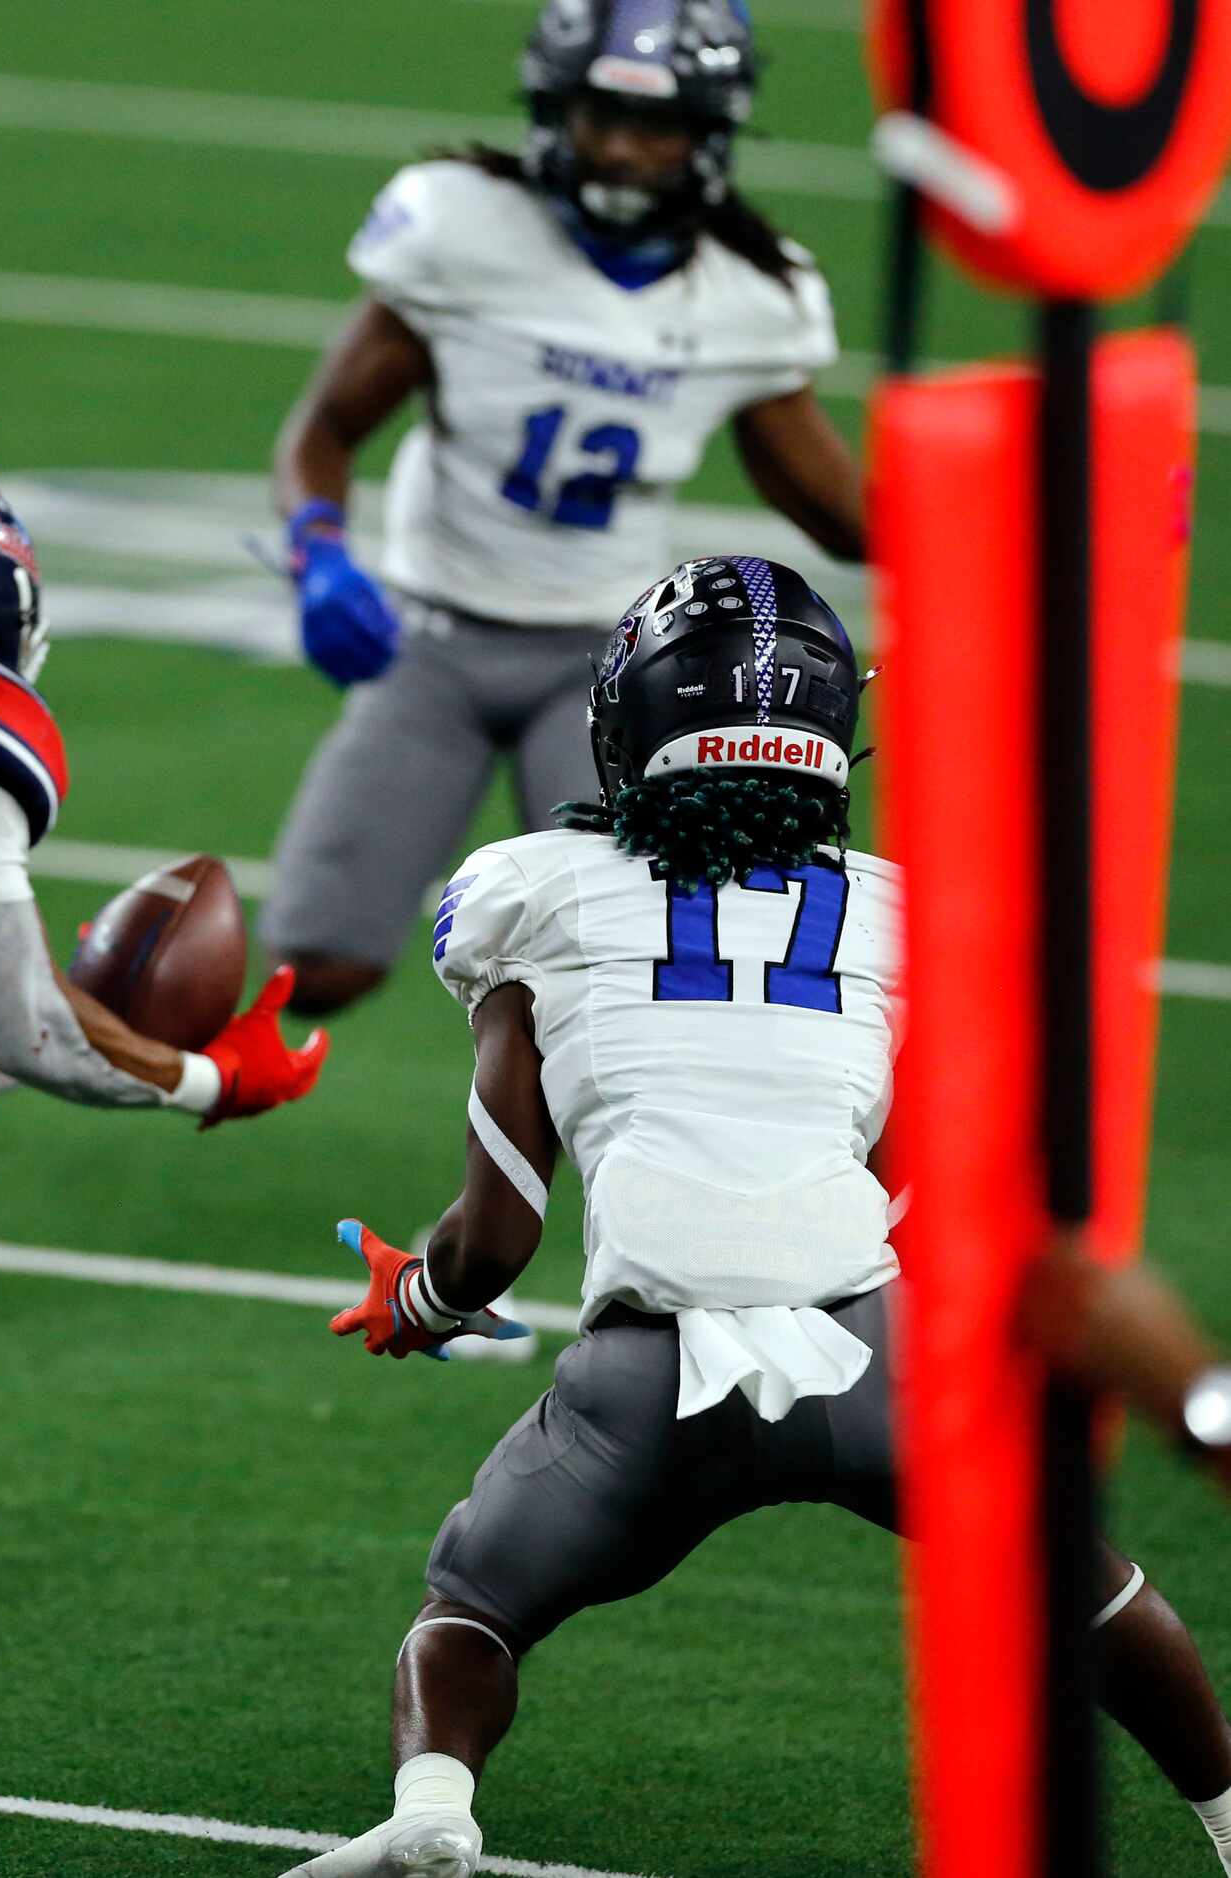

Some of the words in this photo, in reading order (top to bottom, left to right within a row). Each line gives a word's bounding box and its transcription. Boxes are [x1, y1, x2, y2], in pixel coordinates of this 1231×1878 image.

[500, 405, 639, 530] 12
[677, 684, 705, 695] Riddell
[697, 735, 824, 770] Riddell
[648, 857, 850, 1015] 17
